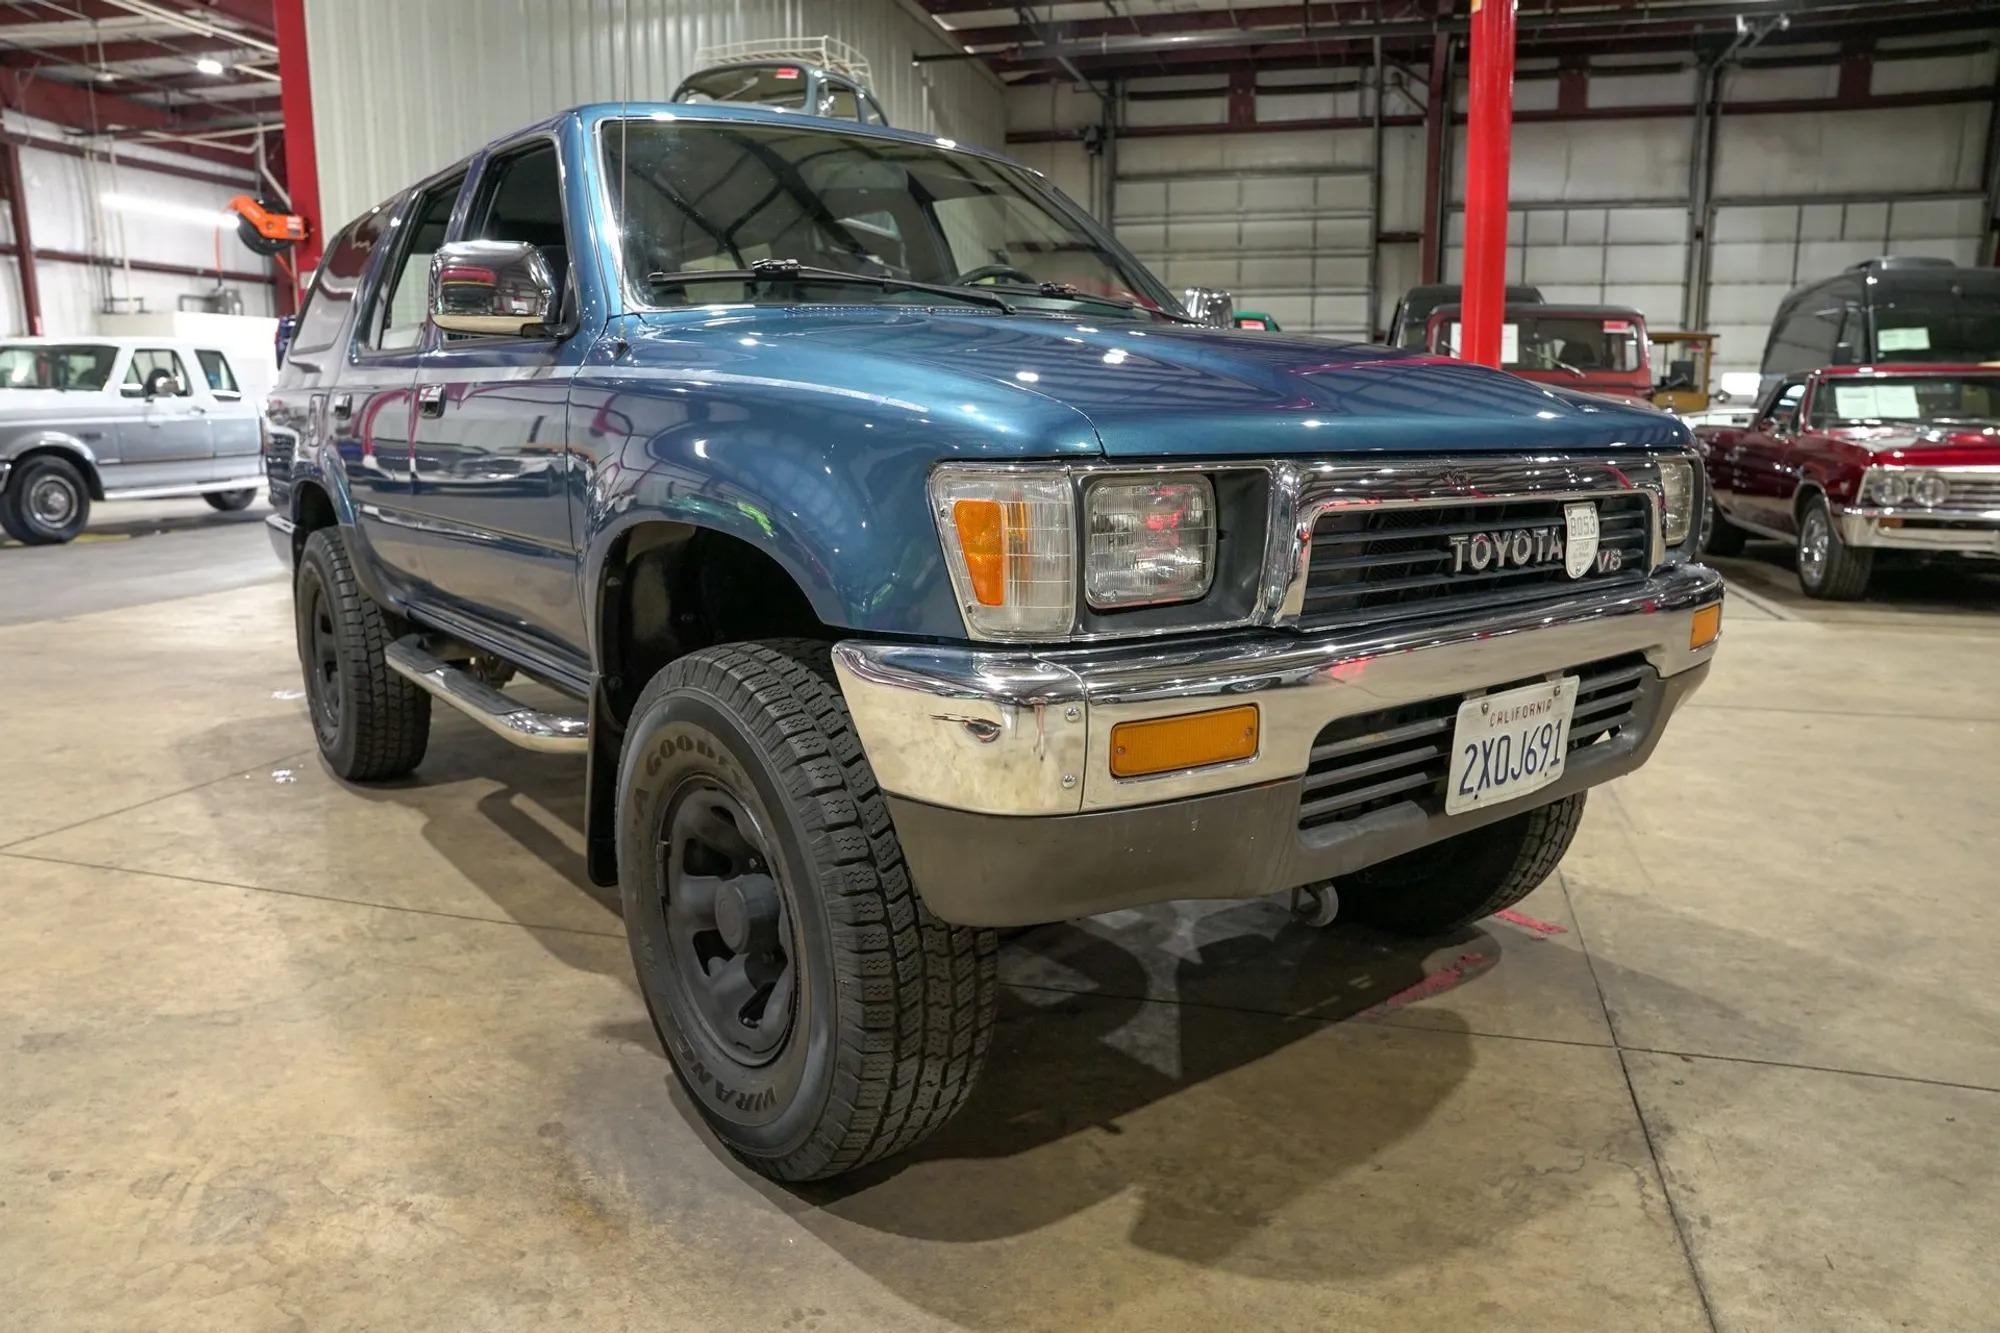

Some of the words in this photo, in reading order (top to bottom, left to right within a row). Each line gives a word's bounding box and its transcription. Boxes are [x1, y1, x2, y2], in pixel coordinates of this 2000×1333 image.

[1449, 526, 1563, 573] TOYOTA
[1596, 548, 1623, 573] V6
[1489, 698, 1553, 727] CALIFORNIA
